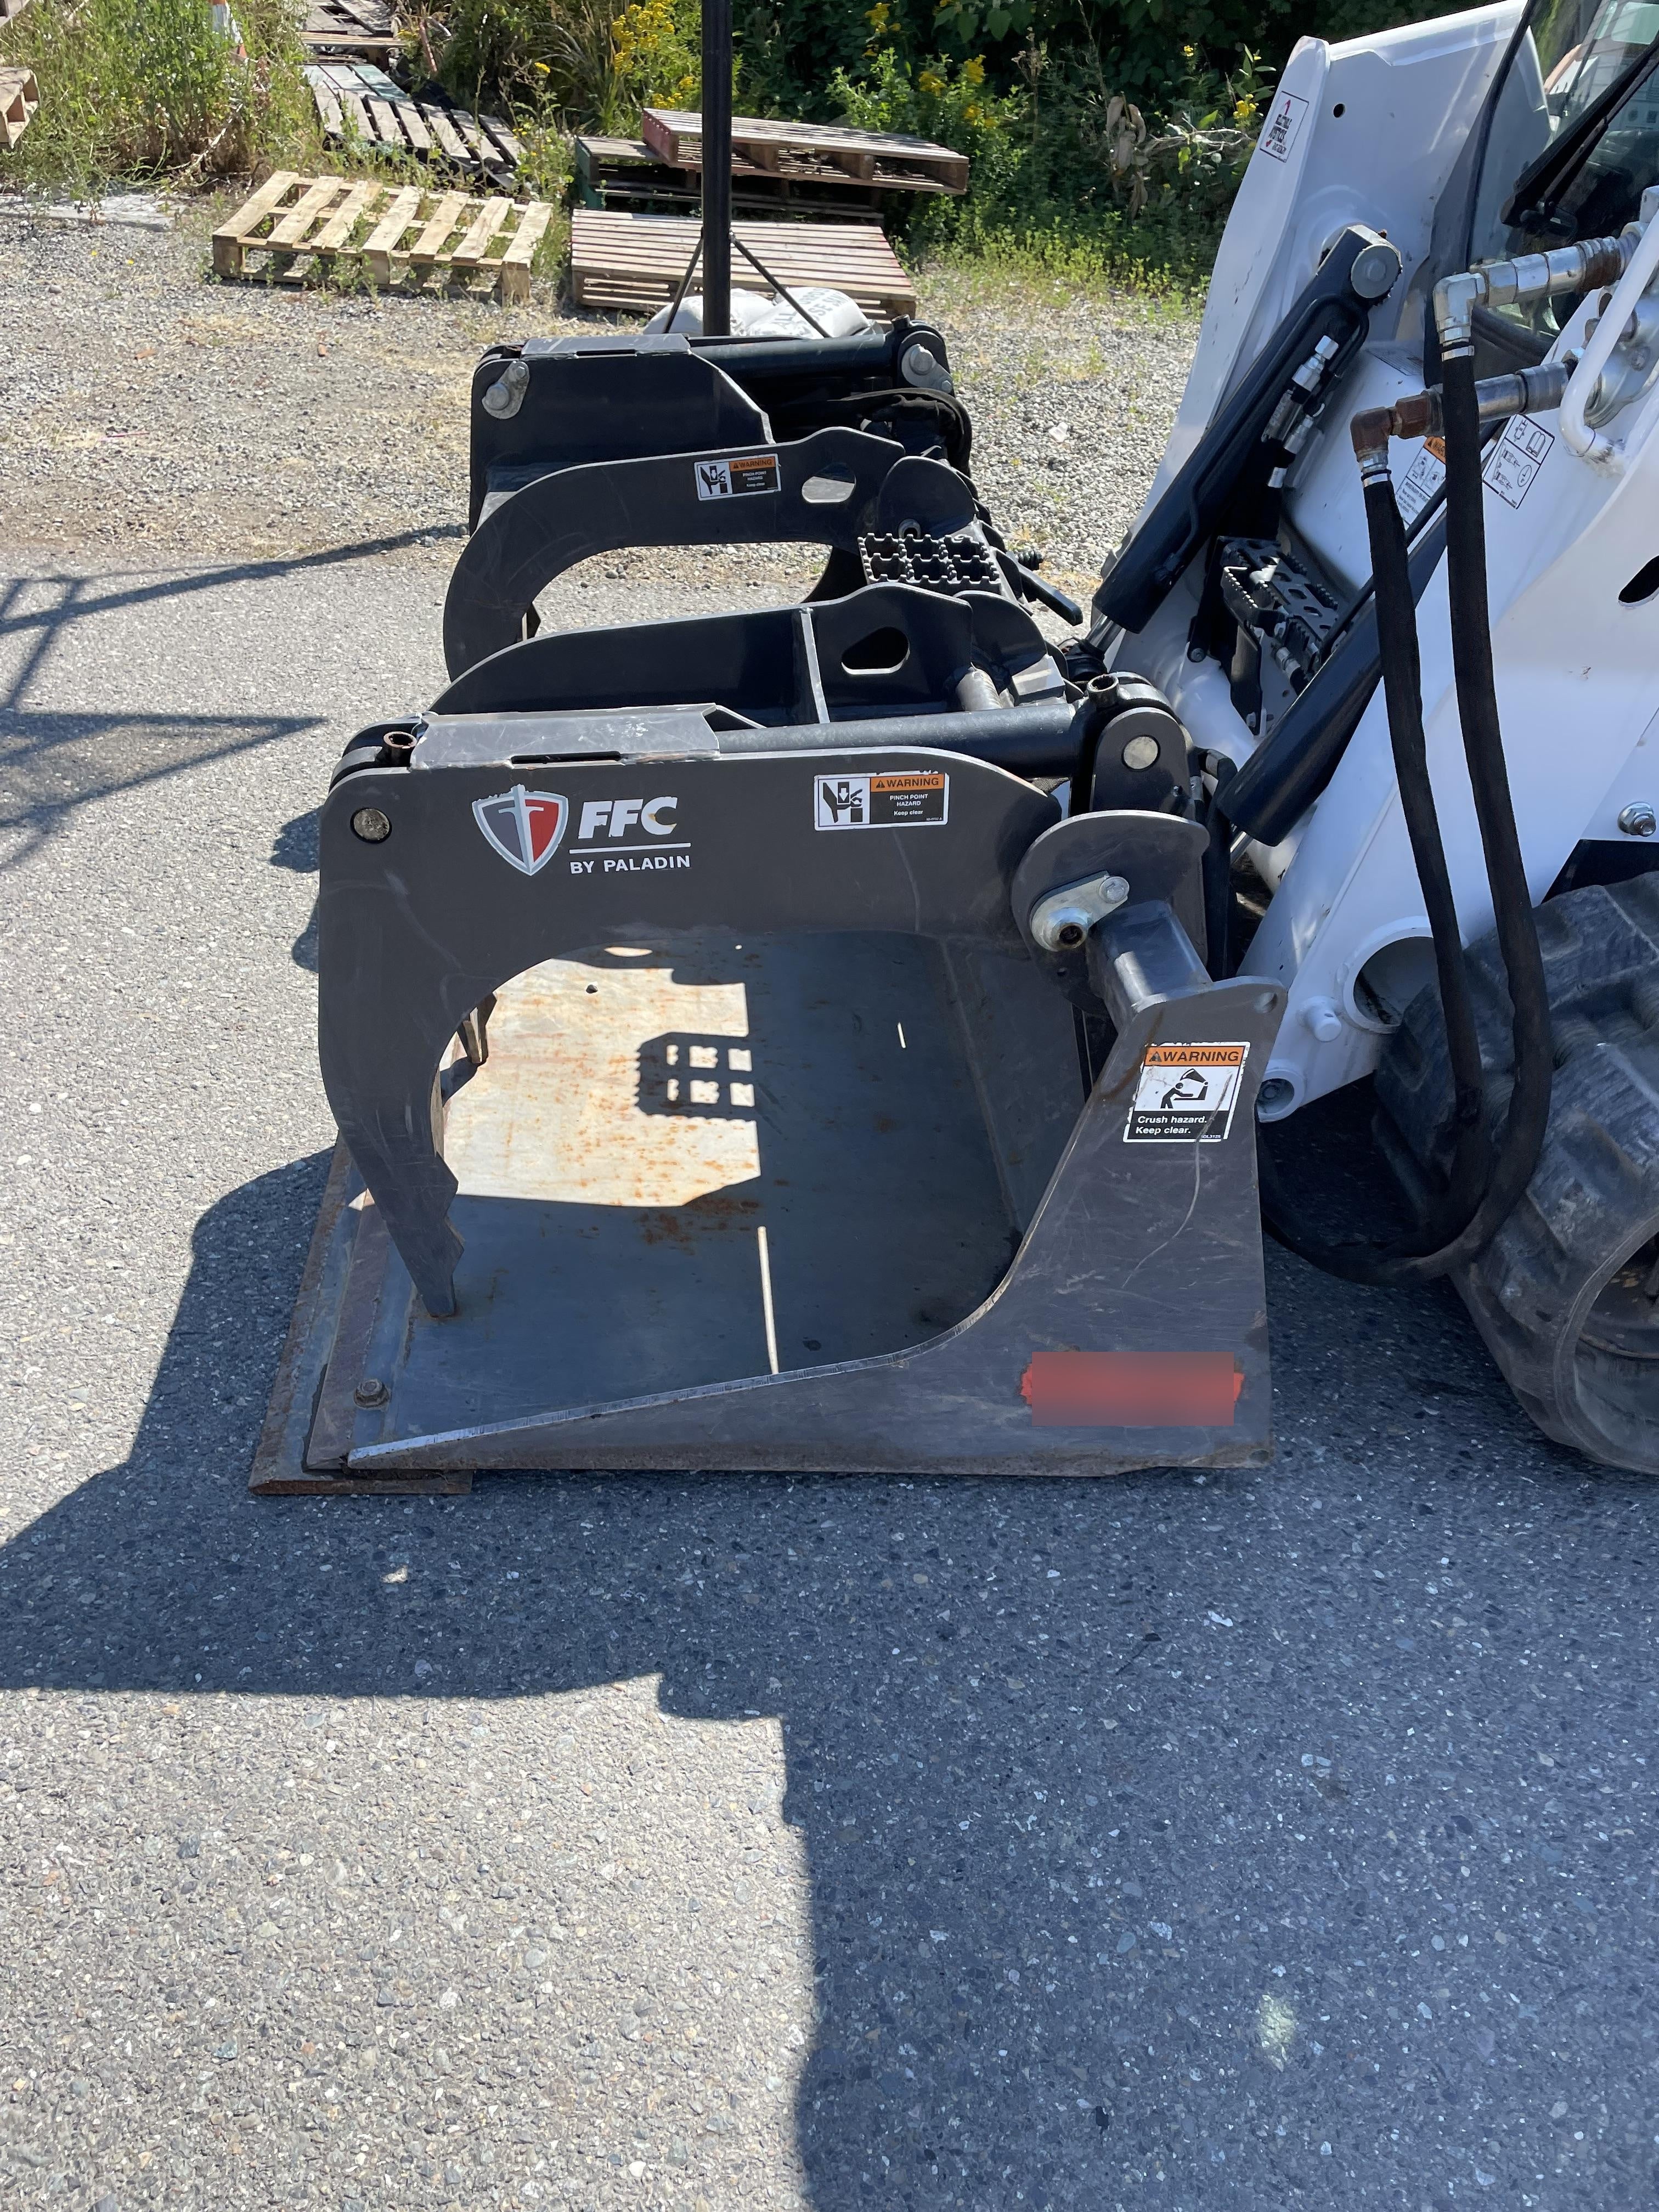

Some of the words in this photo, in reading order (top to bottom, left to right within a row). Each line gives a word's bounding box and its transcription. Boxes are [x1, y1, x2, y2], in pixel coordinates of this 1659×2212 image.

[738, 459, 772, 467] WARNING
[887, 777, 939, 788] WARNING
[578, 796, 678, 839] FFC
[569, 860, 595, 874] BY
[603, 855, 691, 872] PALADIN
[1163, 1051, 1239, 1062] WARNING
[1137, 1115, 1168, 1124] Crush
[1170, 1115, 1207, 1124] hazard.
[1135, 1126, 1161, 1135] Keep
[1164, 1126, 1191, 1135] clear.
